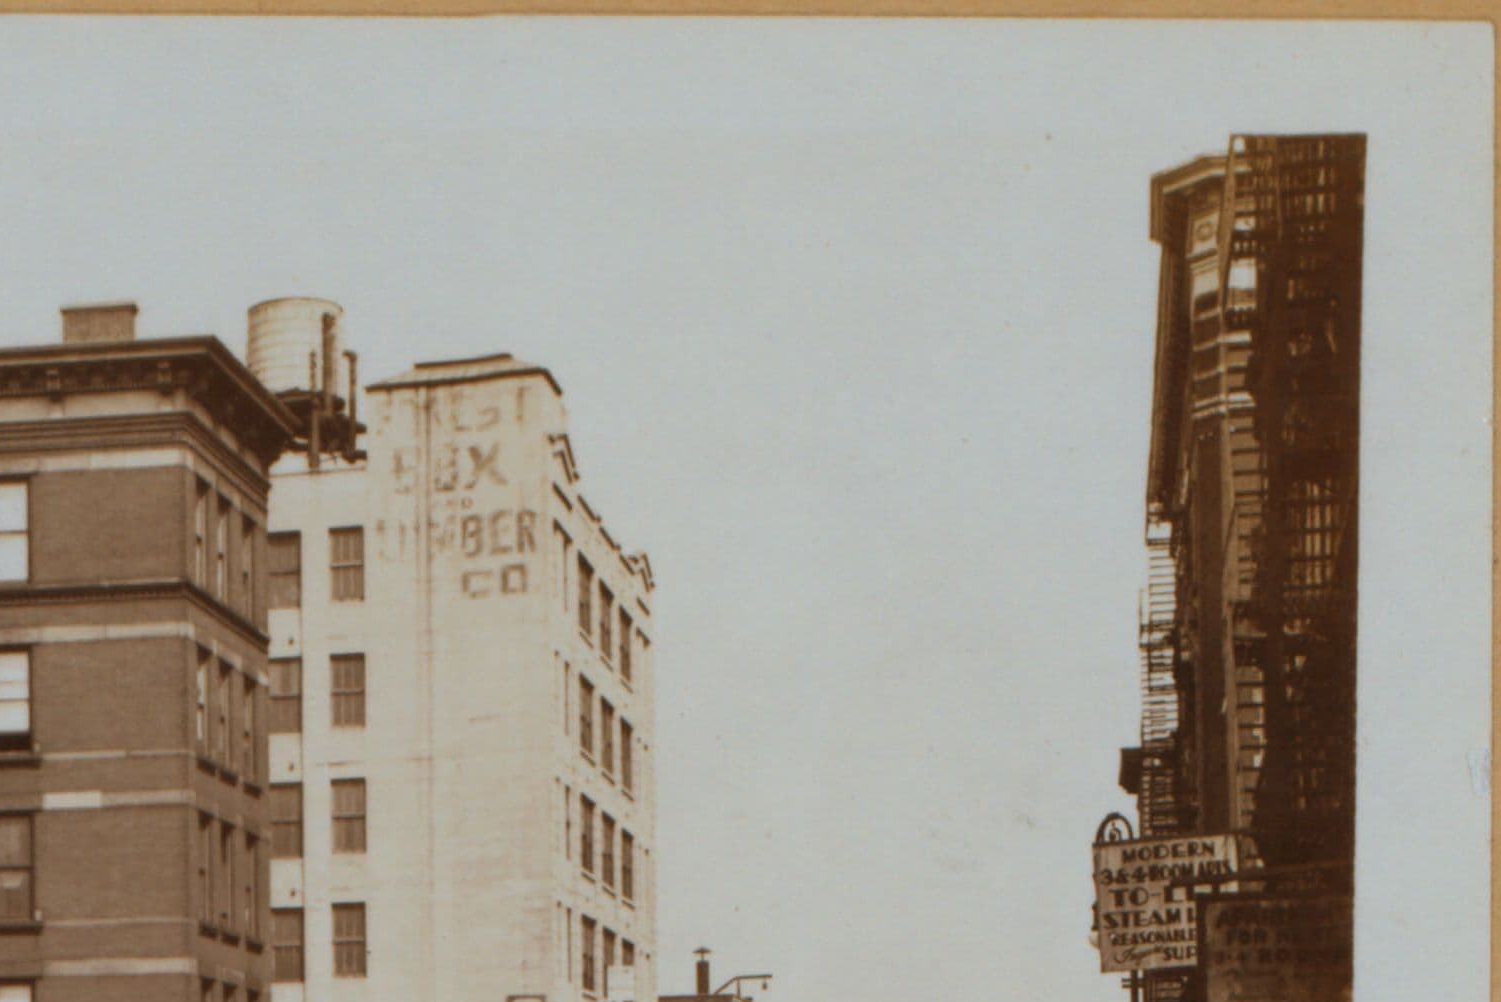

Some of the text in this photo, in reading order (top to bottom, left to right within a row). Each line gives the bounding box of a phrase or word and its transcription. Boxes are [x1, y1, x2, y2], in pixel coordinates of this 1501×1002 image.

[376, 508, 538, 567] MBER
[461, 562, 528, 600] CO
[1121, 840, 1215, 864] MODERN
[1103, 906, 1182, 928] STEAM
[1162, 945, 1197, 962] SUP
